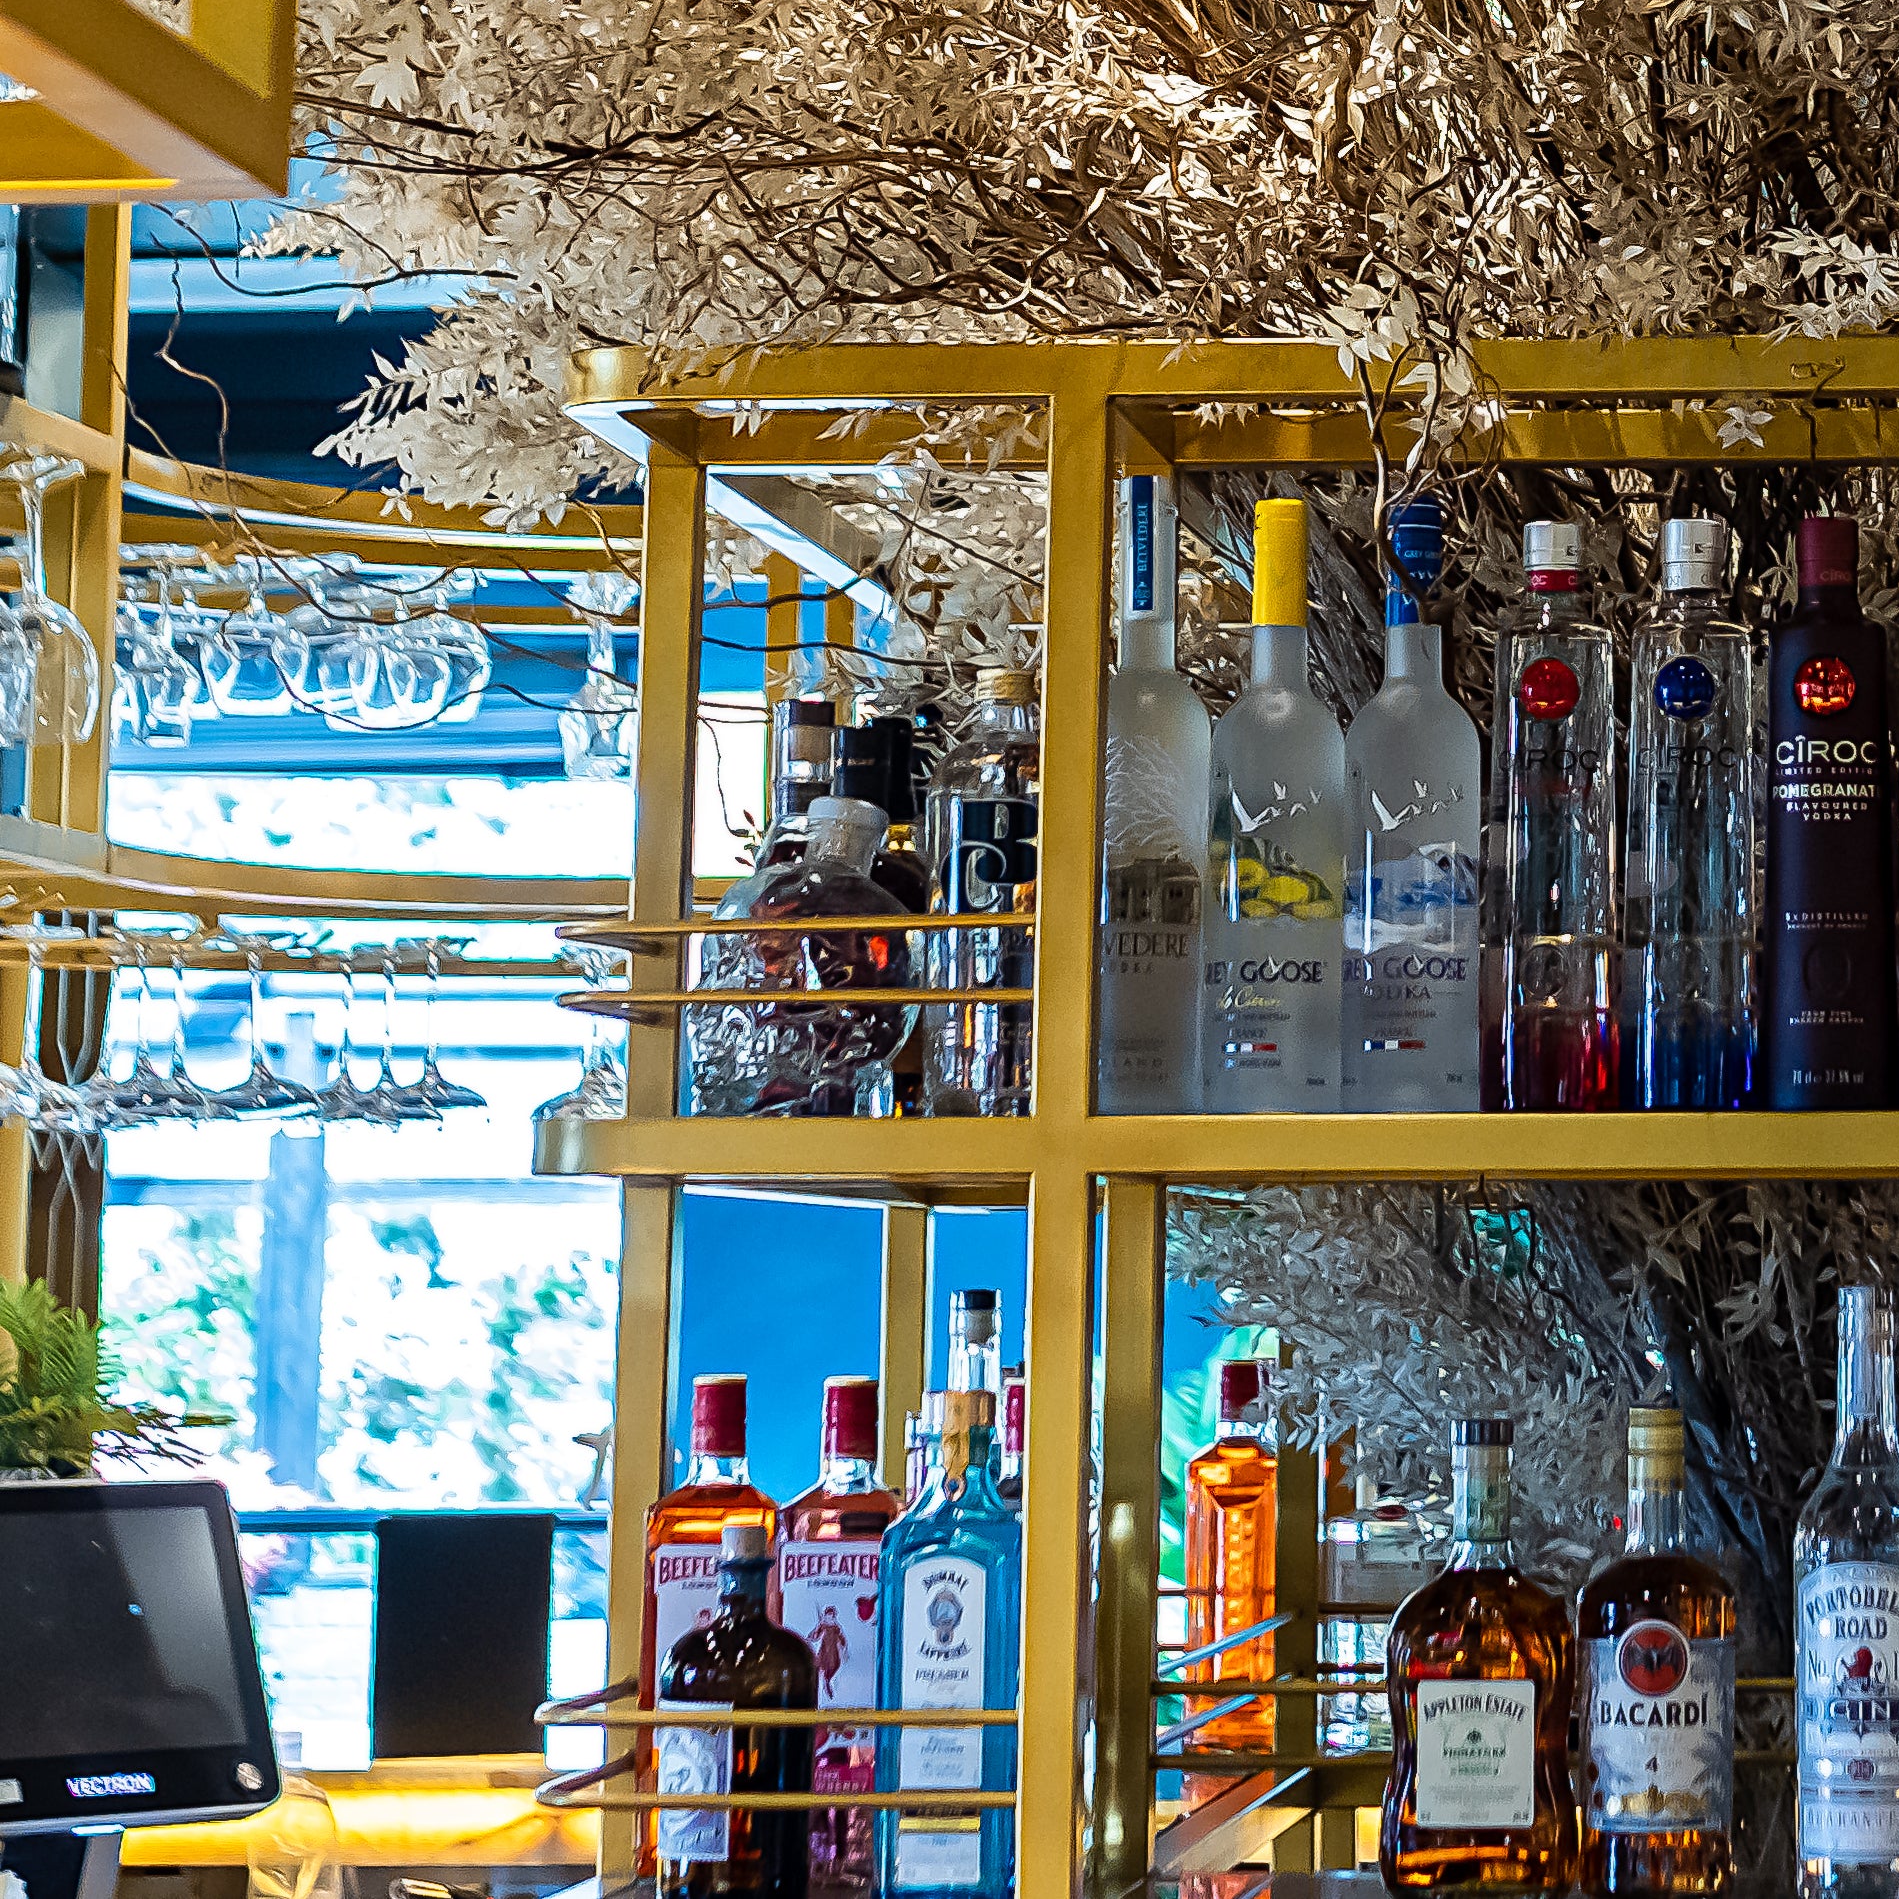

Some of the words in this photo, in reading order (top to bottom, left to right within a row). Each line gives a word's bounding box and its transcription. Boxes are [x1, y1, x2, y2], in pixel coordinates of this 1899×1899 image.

[1240, 955, 1323, 983] GOOSE
[1382, 954, 1468, 981] GOOSE
[785, 1555, 878, 1582] BEEFEATER
[1834, 1617, 1888, 1639] ROAD
[1486, 1693, 1526, 1722] ESTATE
[66, 1772, 155, 1796] VECTRON
